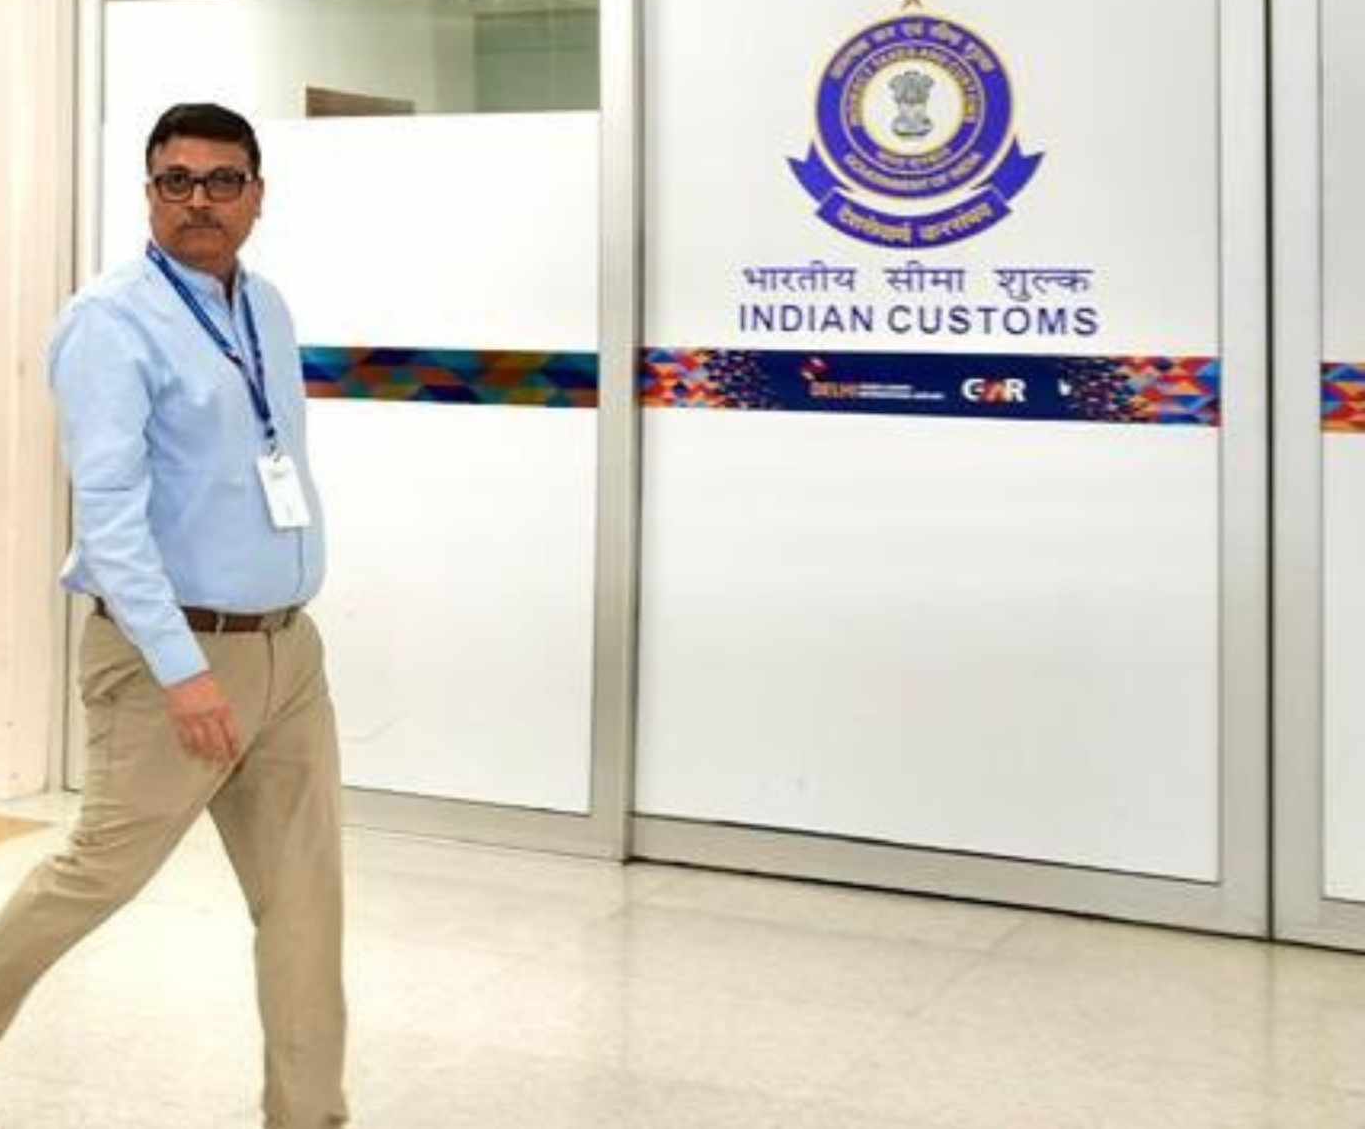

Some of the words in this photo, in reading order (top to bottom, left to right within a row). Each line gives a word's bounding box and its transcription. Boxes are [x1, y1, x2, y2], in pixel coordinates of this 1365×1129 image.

[742, 259, 857, 292] भारतीय
[882, 259, 966, 293] सीमा
[993, 267, 1094, 302] शुल्क
[738, 303, 874, 333] INDIAN
[886, 304, 1100, 336] CUSTOMS
